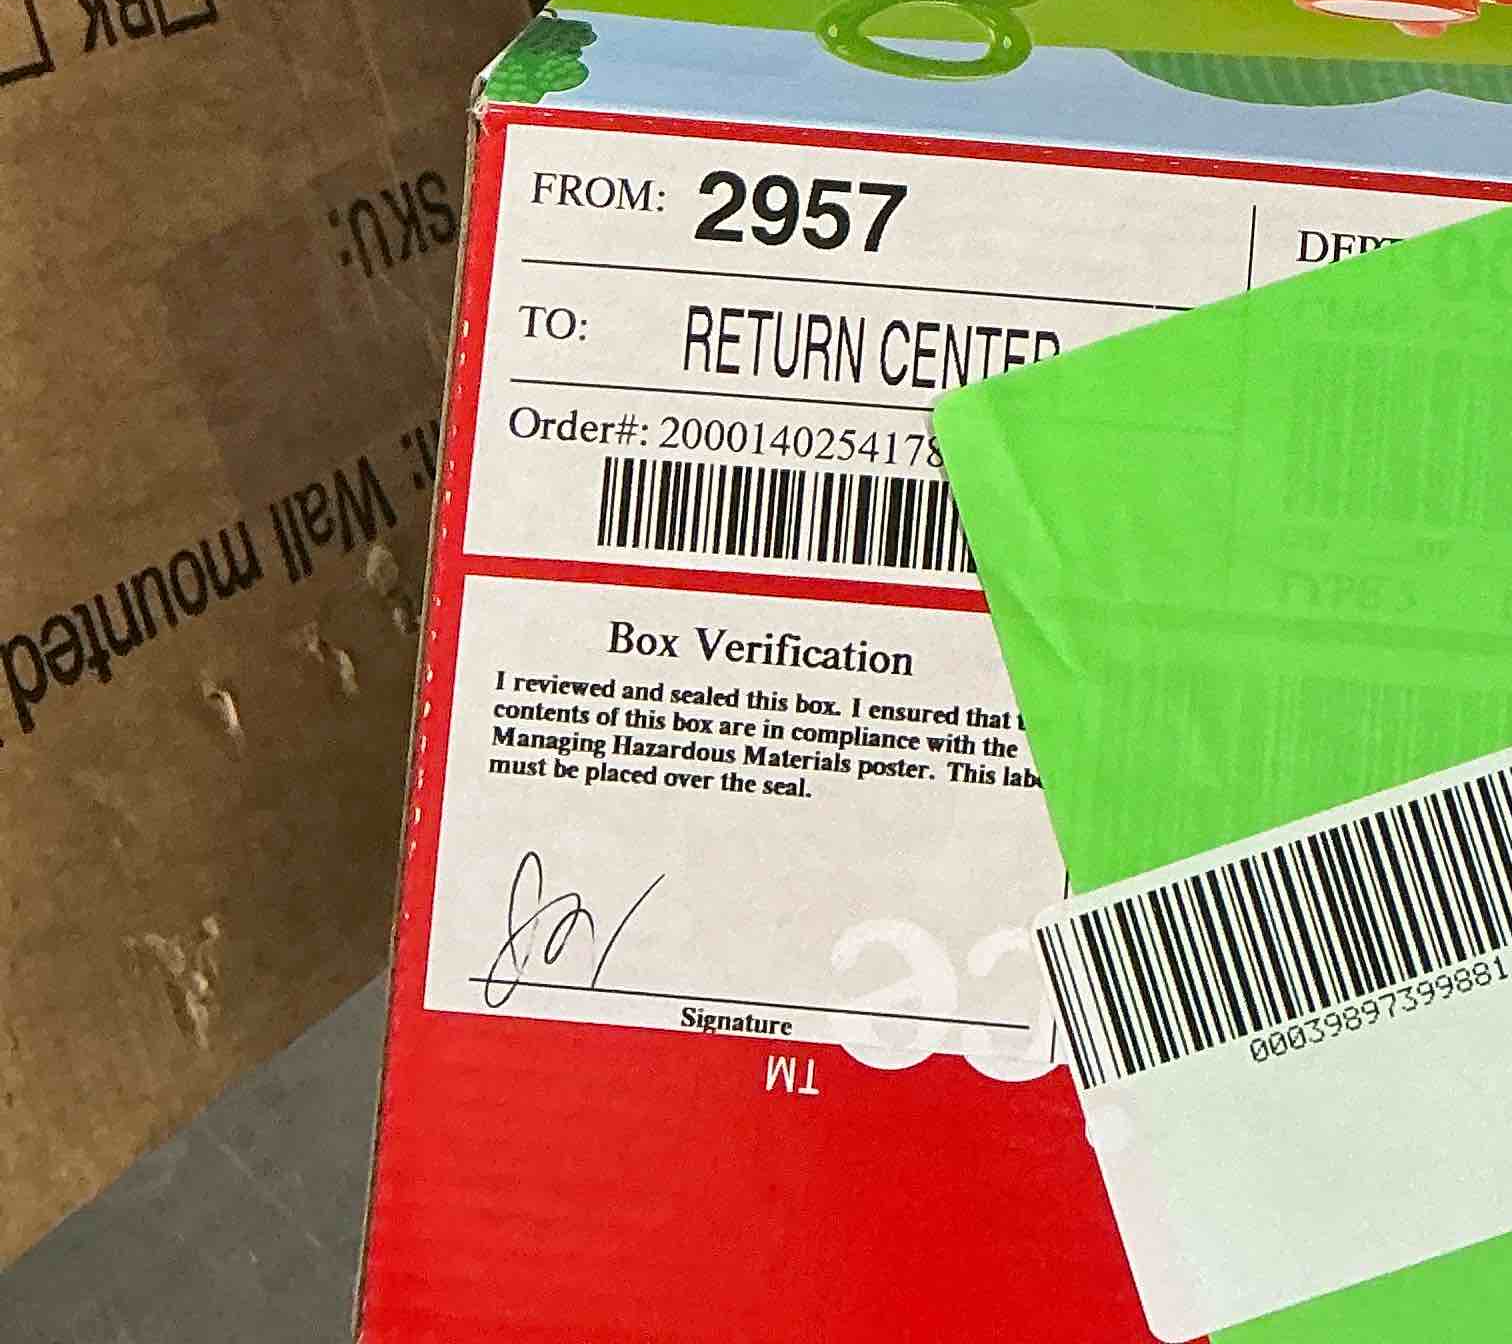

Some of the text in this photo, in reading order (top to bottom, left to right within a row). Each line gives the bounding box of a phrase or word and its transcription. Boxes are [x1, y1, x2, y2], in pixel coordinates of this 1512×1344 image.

[329, 169, 459, 280] SKU:
[530, 169, 908, 253] FROM: 2957
[518, 304, 588, 341] TO:
[682, 303, 866, 385] RETURN
[508, 405, 648, 448] Order#:
[269, 455, 398, 584] Wall
[1, 519, 266, 735] mounted
[605, 619, 914, 676] Box Verification
[492, 700, 1020, 759] contents of this box are in compliance with the
[495, 669, 506, 691] I
[512, 673, 617, 699] reviewed
[621, 681, 665, 703] and
[670, 685, 740, 710] sealed
[746, 689, 790, 712] this
[795, 693, 842, 716] box.
[851, 697, 861, 718] I
[868, 701, 960, 726] ensured
[965, 706, 1013, 731] that
[488, 755, 813, 800] must be placed over the seal.
[491, 724, 607, 760] Managing
[611, 733, 738, 765] Hazardous
[742, 744, 852, 775] Materials
[857, 757, 937, 782] poster.
[946, 761, 997, 786] This
[680, 1006, 794, 1037] Signature
[1249, 955, 1510, 1063] 00039897399881
[764, 1054, 820, 1096] TM
